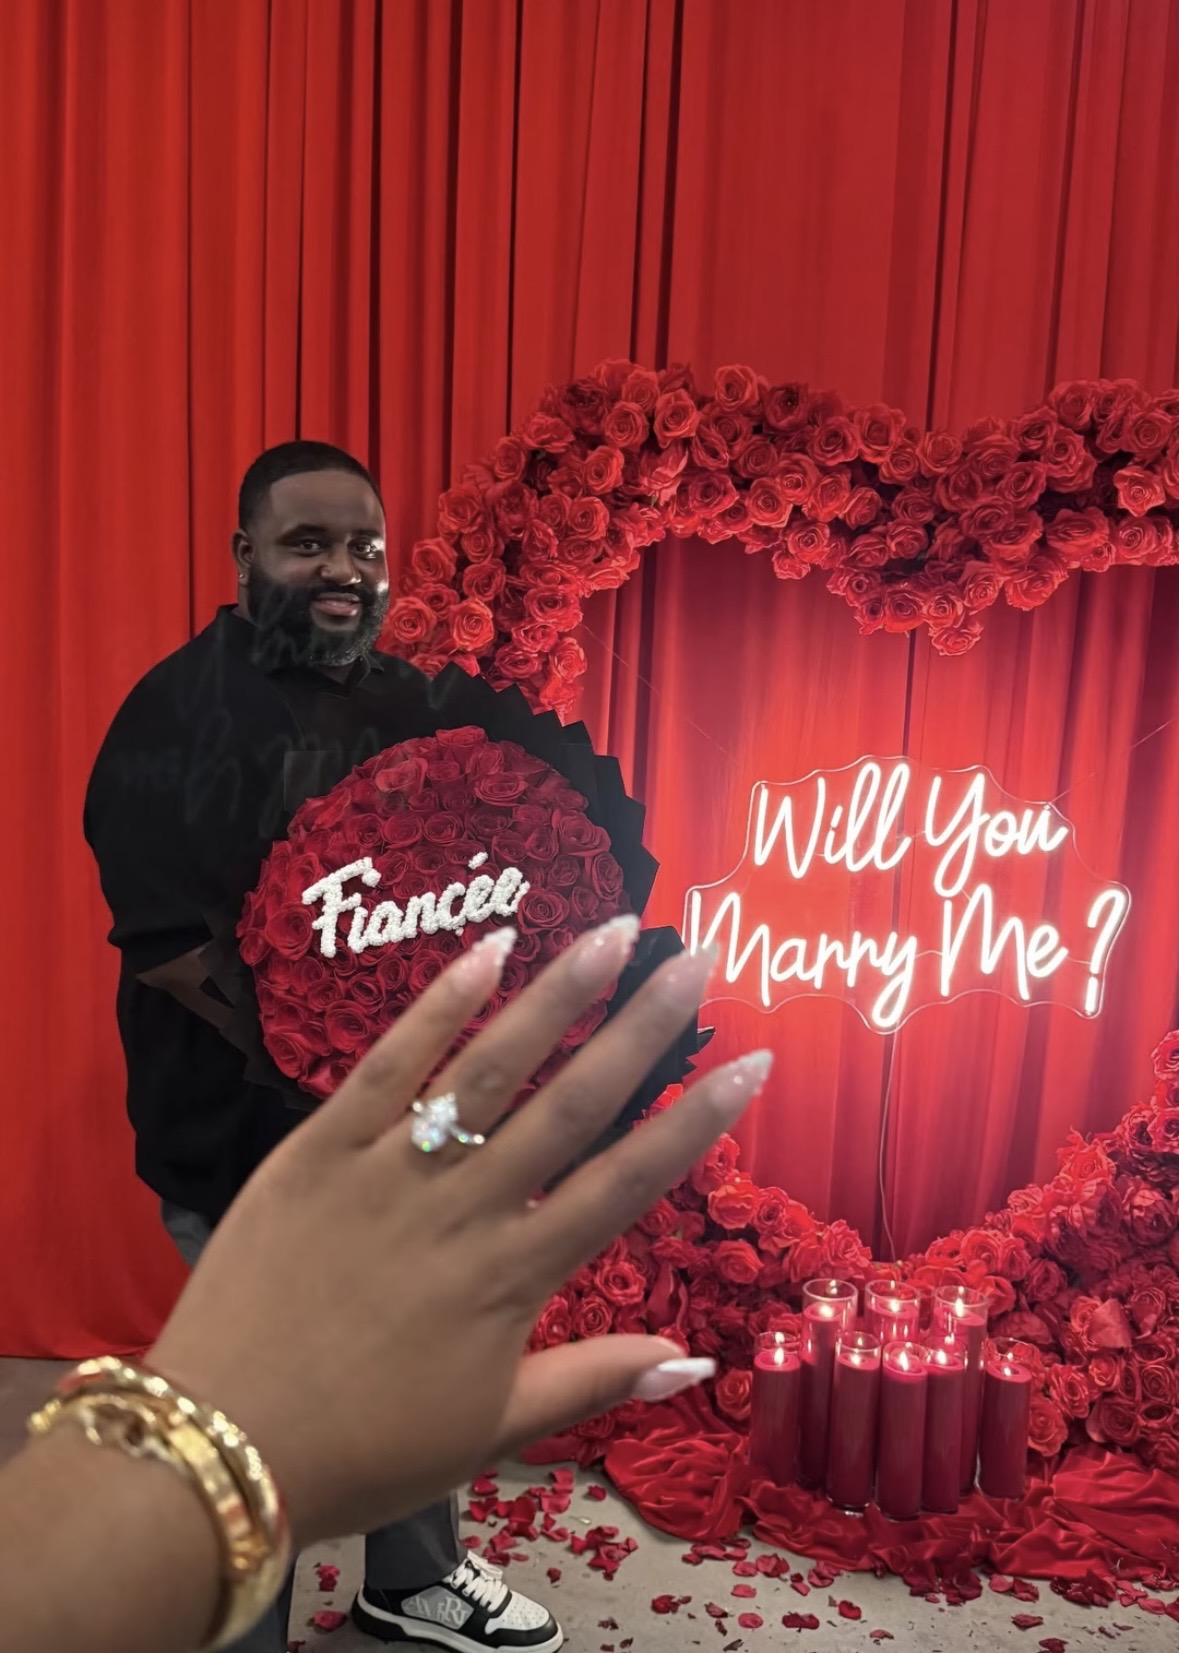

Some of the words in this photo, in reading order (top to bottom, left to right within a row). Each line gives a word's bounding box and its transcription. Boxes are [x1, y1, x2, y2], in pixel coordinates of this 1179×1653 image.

[753, 762, 912, 879] Will
[924, 770, 1069, 898] You
[302, 851, 531, 958] Fiancée
[689, 889, 918, 1029] Marry
